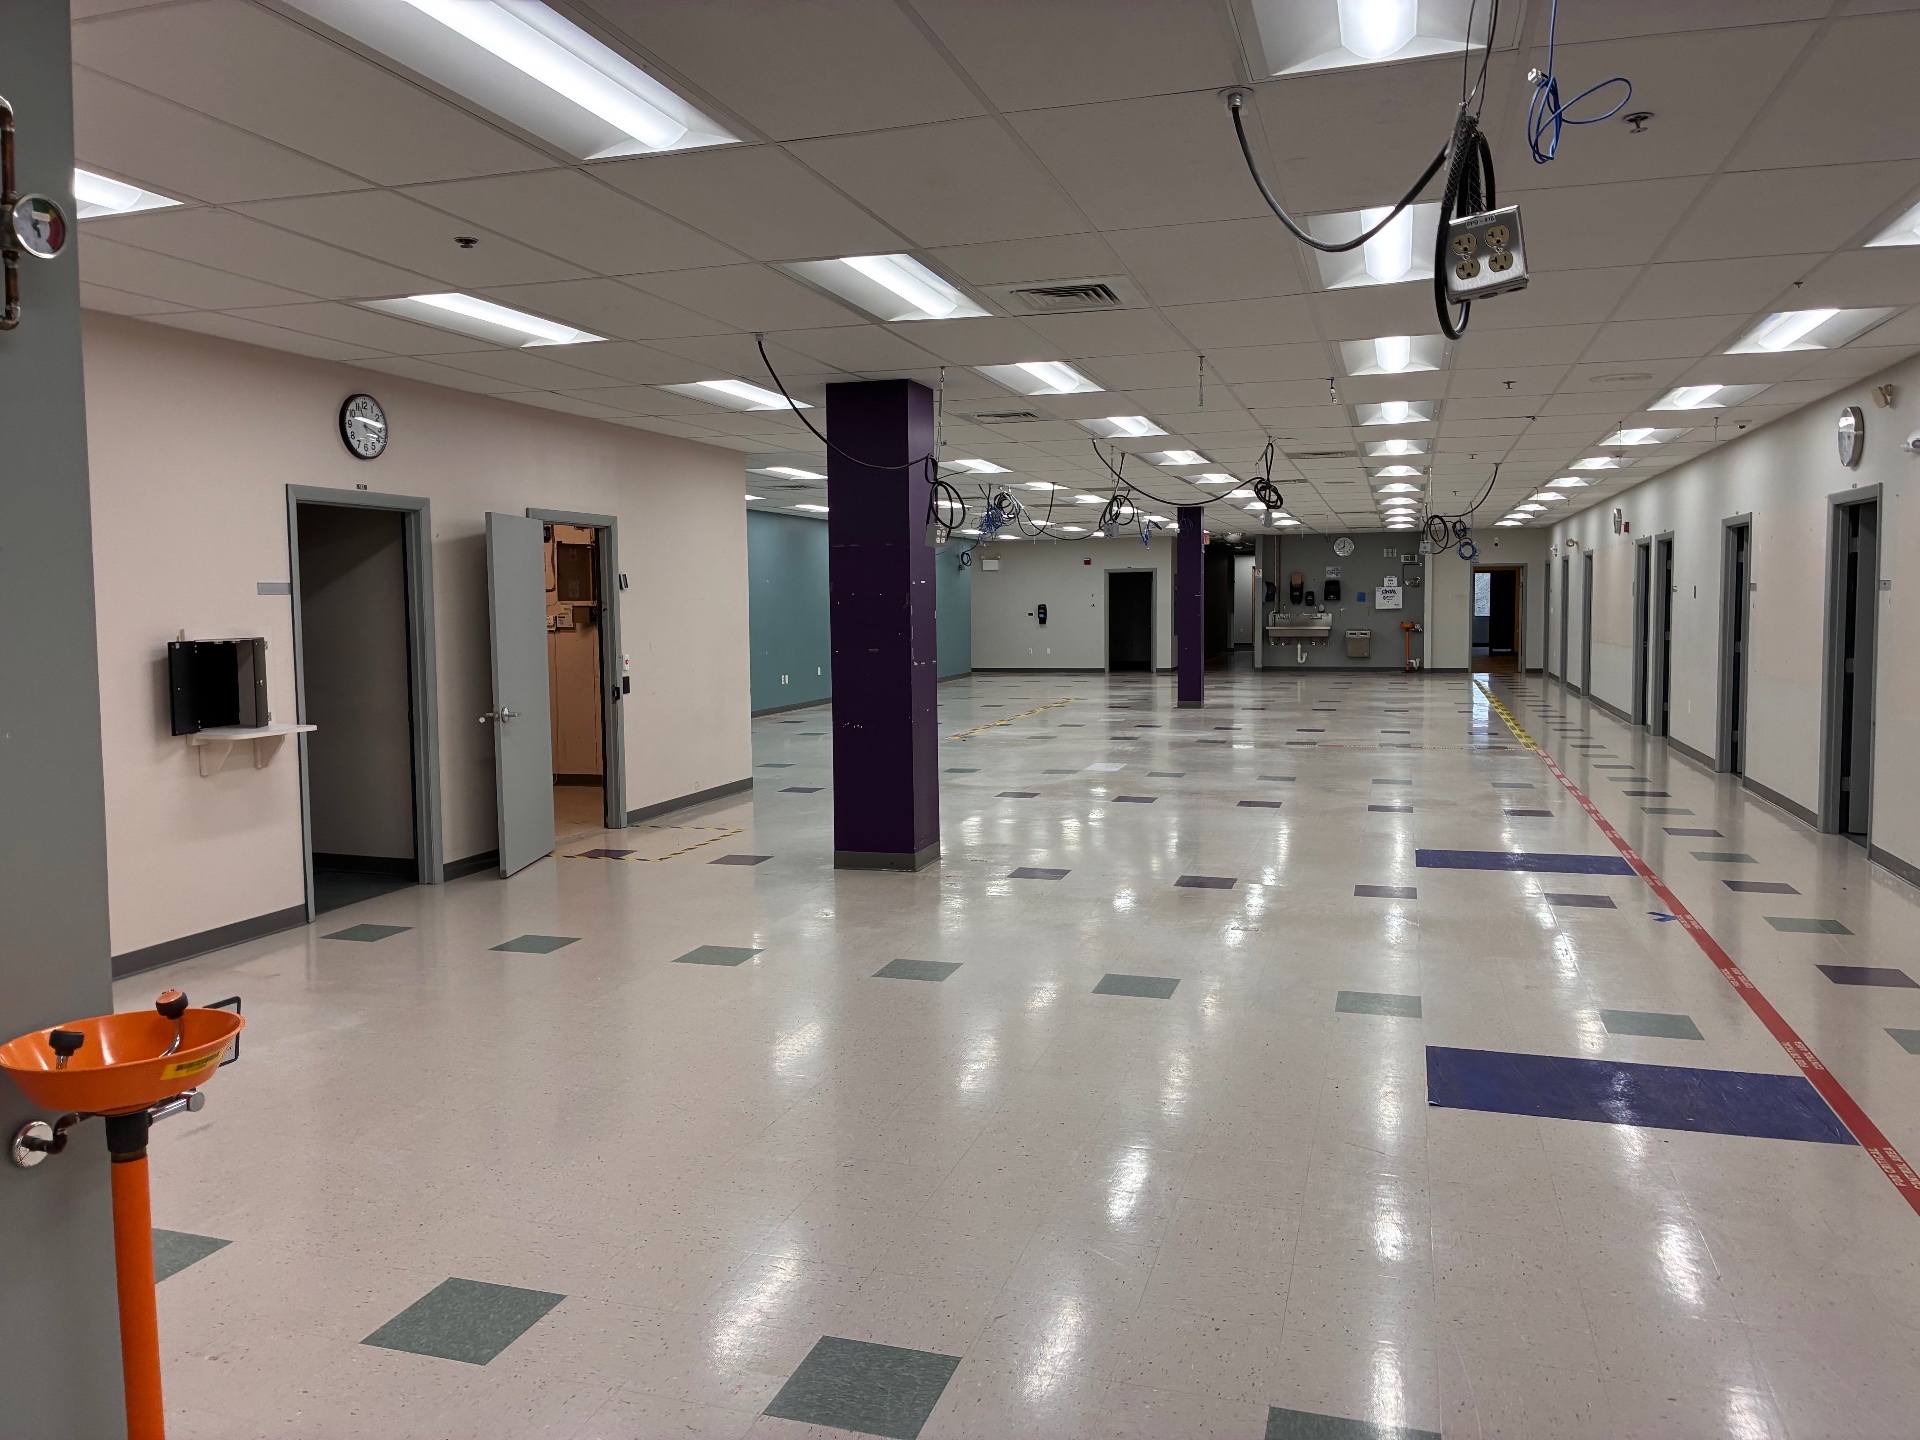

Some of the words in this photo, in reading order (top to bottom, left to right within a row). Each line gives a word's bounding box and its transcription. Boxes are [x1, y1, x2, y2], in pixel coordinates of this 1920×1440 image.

[355, 402, 360, 411] 11
[362, 400, 368, 410] 12
[349, 409, 356, 417] 10
[374, 414, 380, 422] 2
[348, 420, 352, 428] 9
[350, 431, 355, 440] 8
[357, 440, 361, 448] 7
[364, 444, 368, 452] 6
[371, 442, 376, 450] 5
